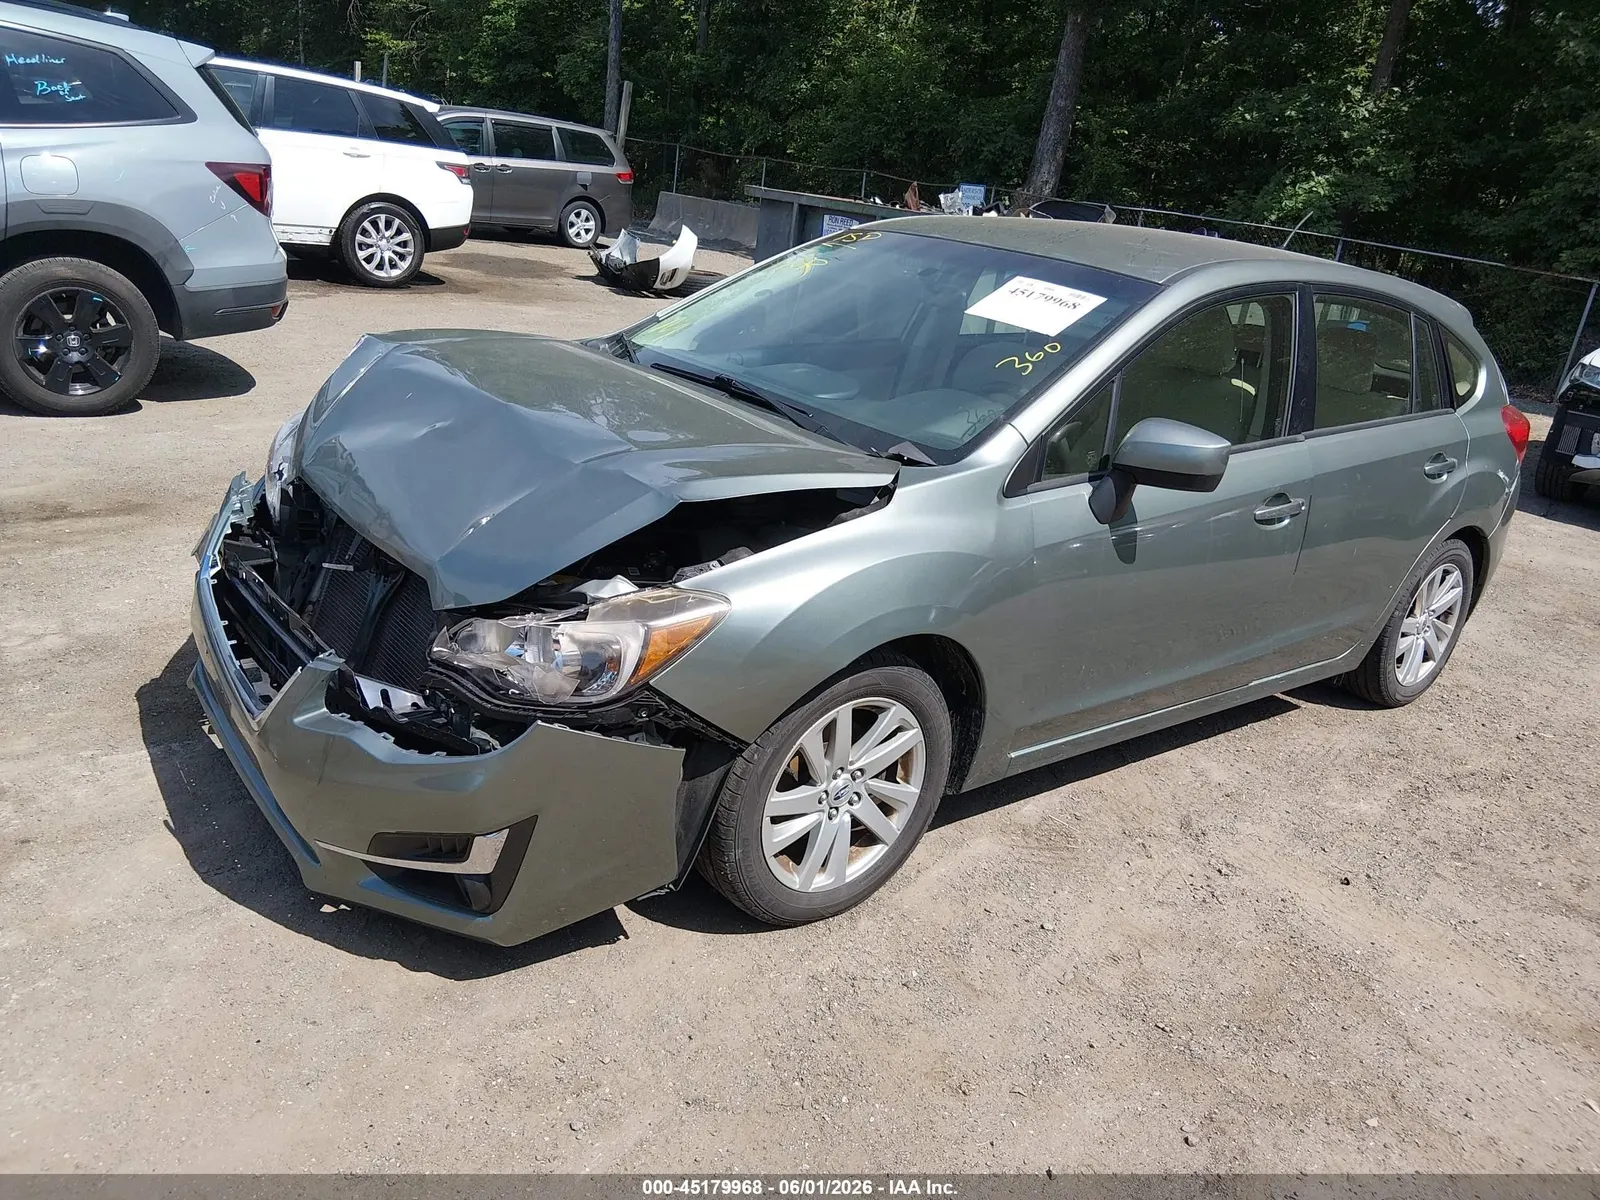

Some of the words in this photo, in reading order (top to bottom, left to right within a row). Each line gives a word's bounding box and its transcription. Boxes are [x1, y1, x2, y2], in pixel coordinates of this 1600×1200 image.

[5, 53, 66, 67] Headliner
[34, 80, 71, 95] Back
[1008, 287, 1081, 310] 45179968
[995, 342, 1061, 376] 360
